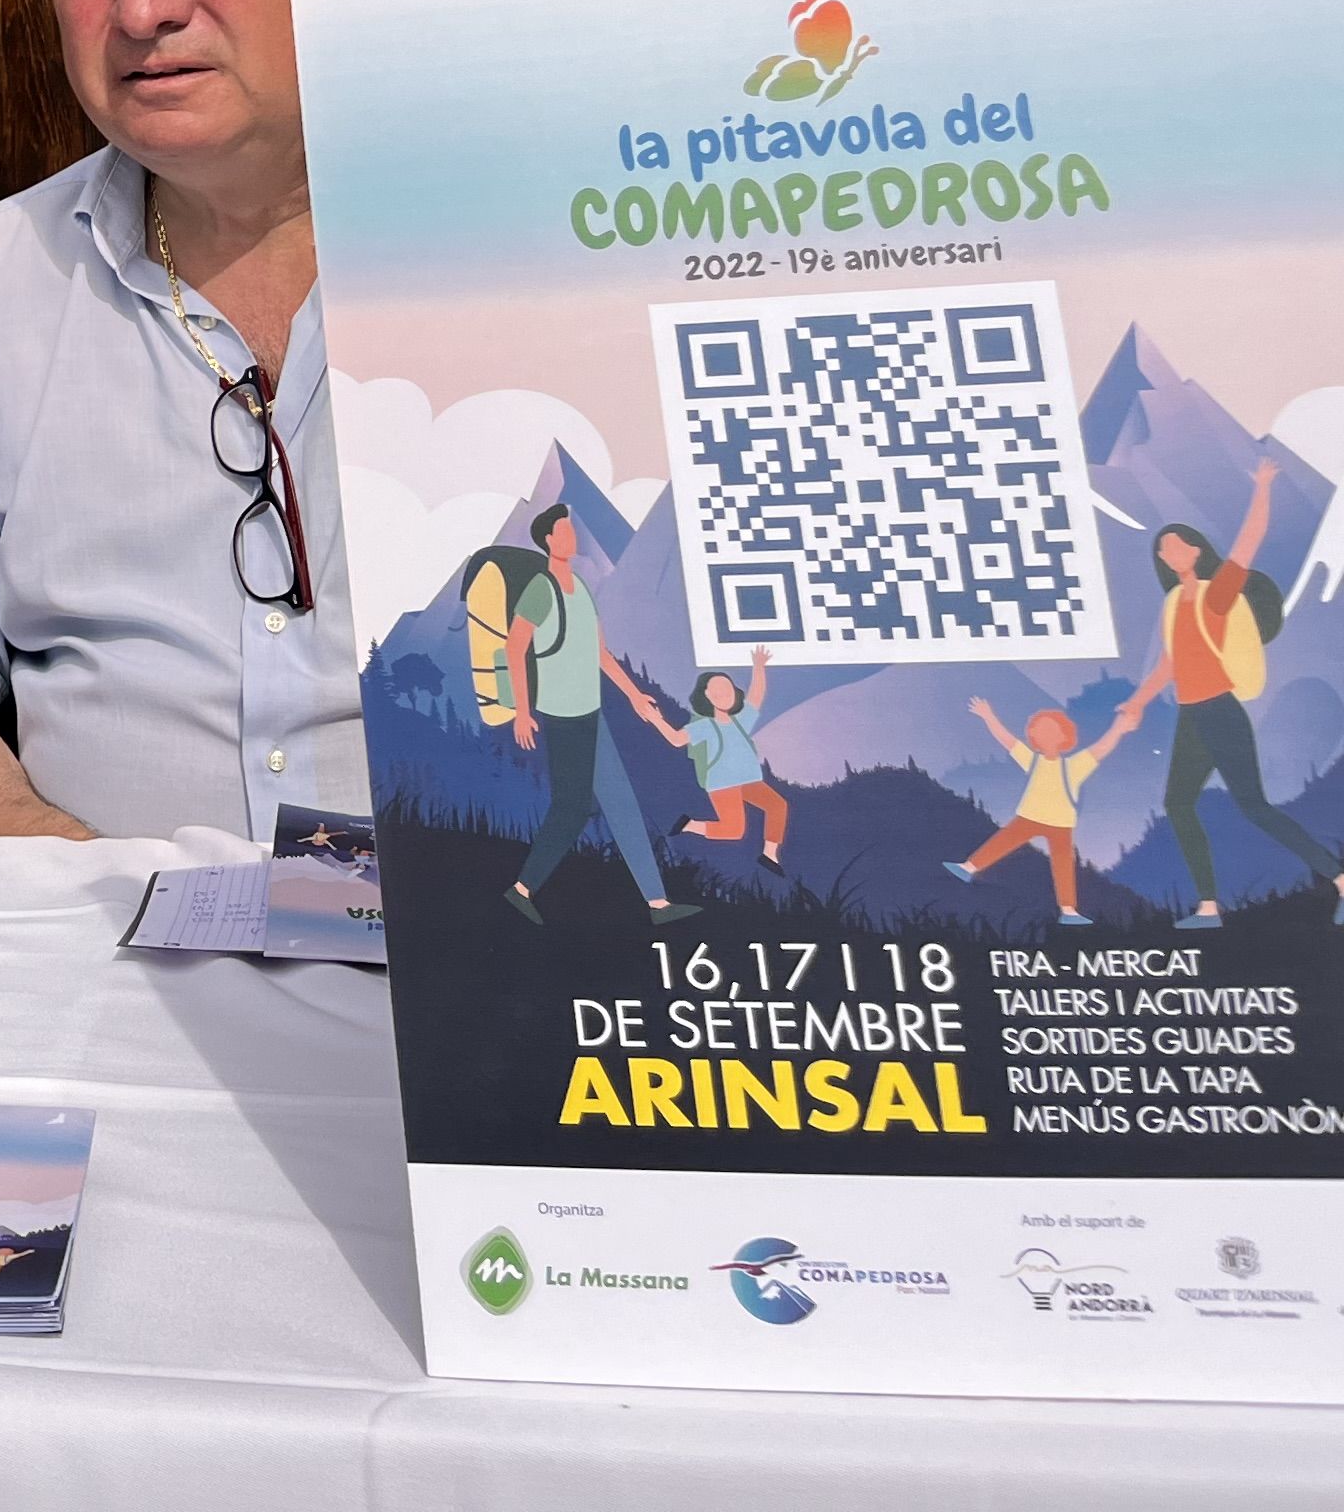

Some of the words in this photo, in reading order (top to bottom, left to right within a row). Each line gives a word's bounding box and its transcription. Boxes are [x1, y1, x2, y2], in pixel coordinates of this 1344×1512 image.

[619, 124, 669, 171] la
[688, 104, 926, 181] pitavola
[943, 92, 1034, 147] del
[570, 153, 1110, 250] COMAPEDROSA
[685, 252, 766, 281] 2022
[788, 248, 836, 274] 19è
[844, 236, 1003, 269] aniversari
[883, 943, 956, 993] 18
[989, 950, 1057, 978] FIRA
[1077, 949, 1202, 977] MERCAT
[993, 988, 1109, 1016] TALLERS
[1133, 987, 1299, 1016] ACTIVITATS
[573, 999, 648, 1048] DE
[669, 1000, 967, 1053] SETEMBRE
[1001, 1027, 1147, 1056] SORTIDES
[1152, 1026, 1296, 1056] GUIADES
[558, 1056, 988, 1134] ARINSAL
[1006, 1066, 1087, 1094] RUTA
[1091, 1066, 1134, 1094] DE
[1139, 1066, 1179, 1094] LA
[1182, 1066, 1262, 1094] TAPA
[1013, 1098, 1130, 1133] MENÚS
[1136, 1098, 1344, 1135] GASTRONÒM
[537, 1201, 605, 1219] Organitza
[1021, 1214, 1056, 1228] Amb
[1059, 1214, 1073, 1228] el
[1075, 1216, 1123, 1231] suport
[1127, 1216, 1146, 1229] de
[545, 1266, 574, 1287] La
[580, 1268, 689, 1291] Massana
[1064, 1283, 1114, 1296] NORD
